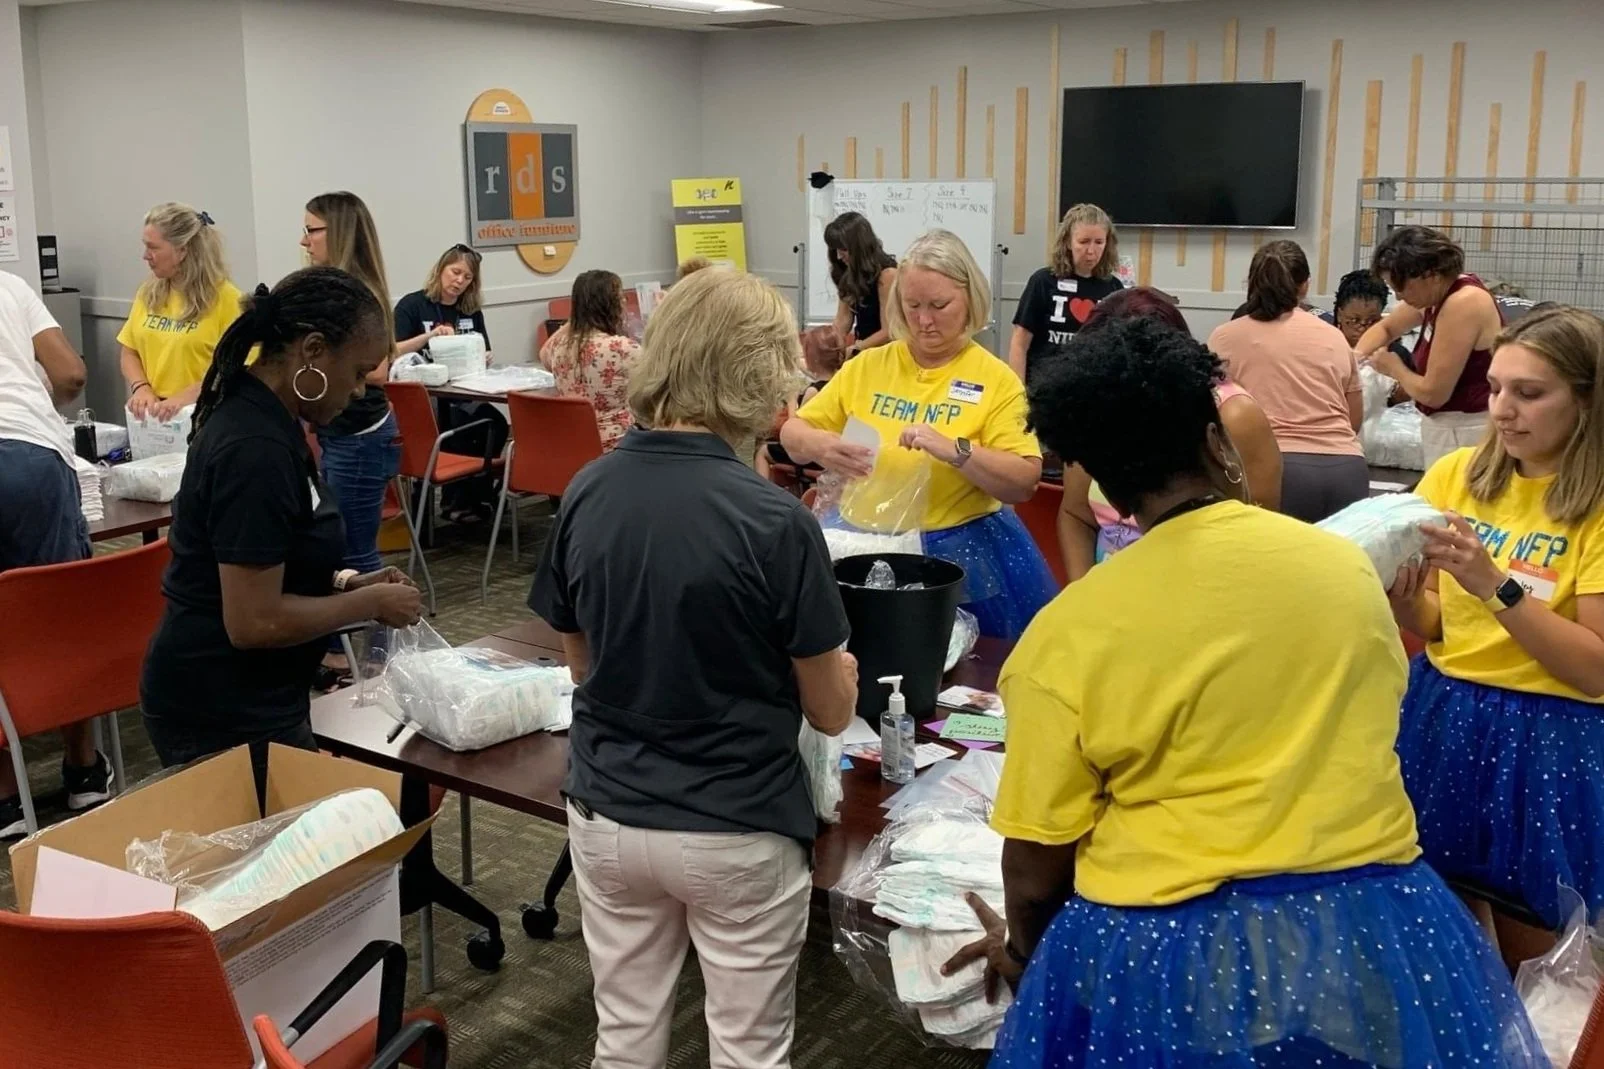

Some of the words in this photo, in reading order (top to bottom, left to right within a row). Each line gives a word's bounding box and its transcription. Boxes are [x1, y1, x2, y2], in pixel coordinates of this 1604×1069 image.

[484, 153, 567, 194] rds
[142, 314, 172, 332] TEAM
[1050, 295, 1068, 323] I
[871, 393, 919, 423] TEAM
[922, 404, 961, 425] NFP
[1508, 531, 1569, 567] NFP
